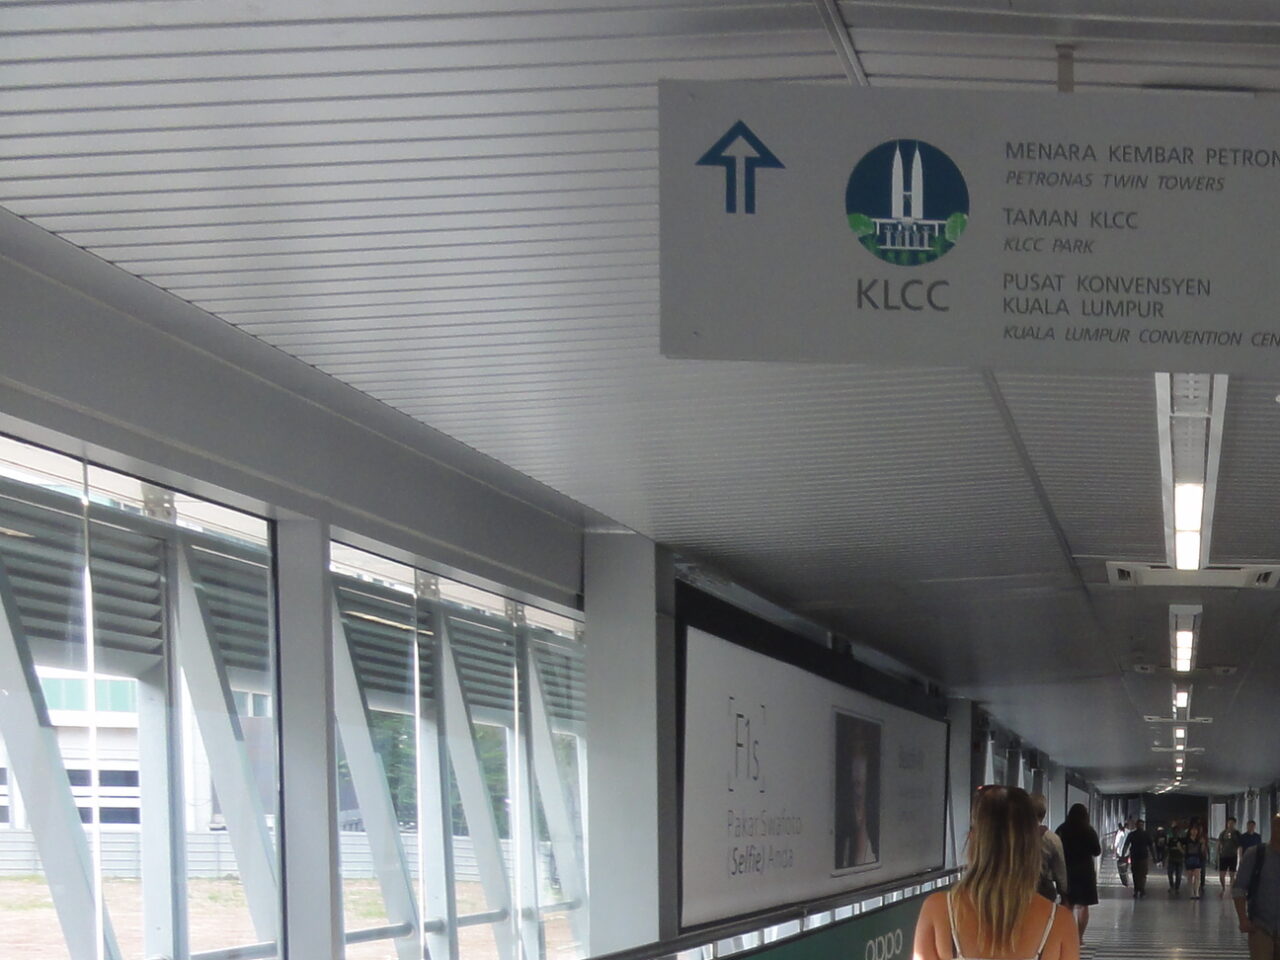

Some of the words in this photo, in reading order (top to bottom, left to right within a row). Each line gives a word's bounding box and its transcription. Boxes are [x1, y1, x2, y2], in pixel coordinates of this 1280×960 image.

[1006, 141, 1097, 162] MENARA
[1109, 145, 1194, 164] KEMBAR
[1006, 170, 1092, 187] PETRONAS
[1104, 173, 1148, 189] TWIN
[1158, 175, 1224, 191] TOWERS
[1003, 208, 1078, 227] TAMAN
[1090, 211, 1138, 230] KLCC
[1004, 237, 1044, 252] KLCC
[1052, 238, 1094, 253] PARK
[1003, 272, 1065, 292] PUSAT
[1077, 275, 1210, 296] KONVENSYEN
[856, 278, 949, 312] KLCC
[1003, 297, 1069, 315] KUALA
[1082, 299, 1164, 318] LUMPUR
[1003, 326, 1055, 340] KUALA
[1065, 327, 1130, 342] LUMPUR
[1139, 329, 1243, 346] CONVENTION
